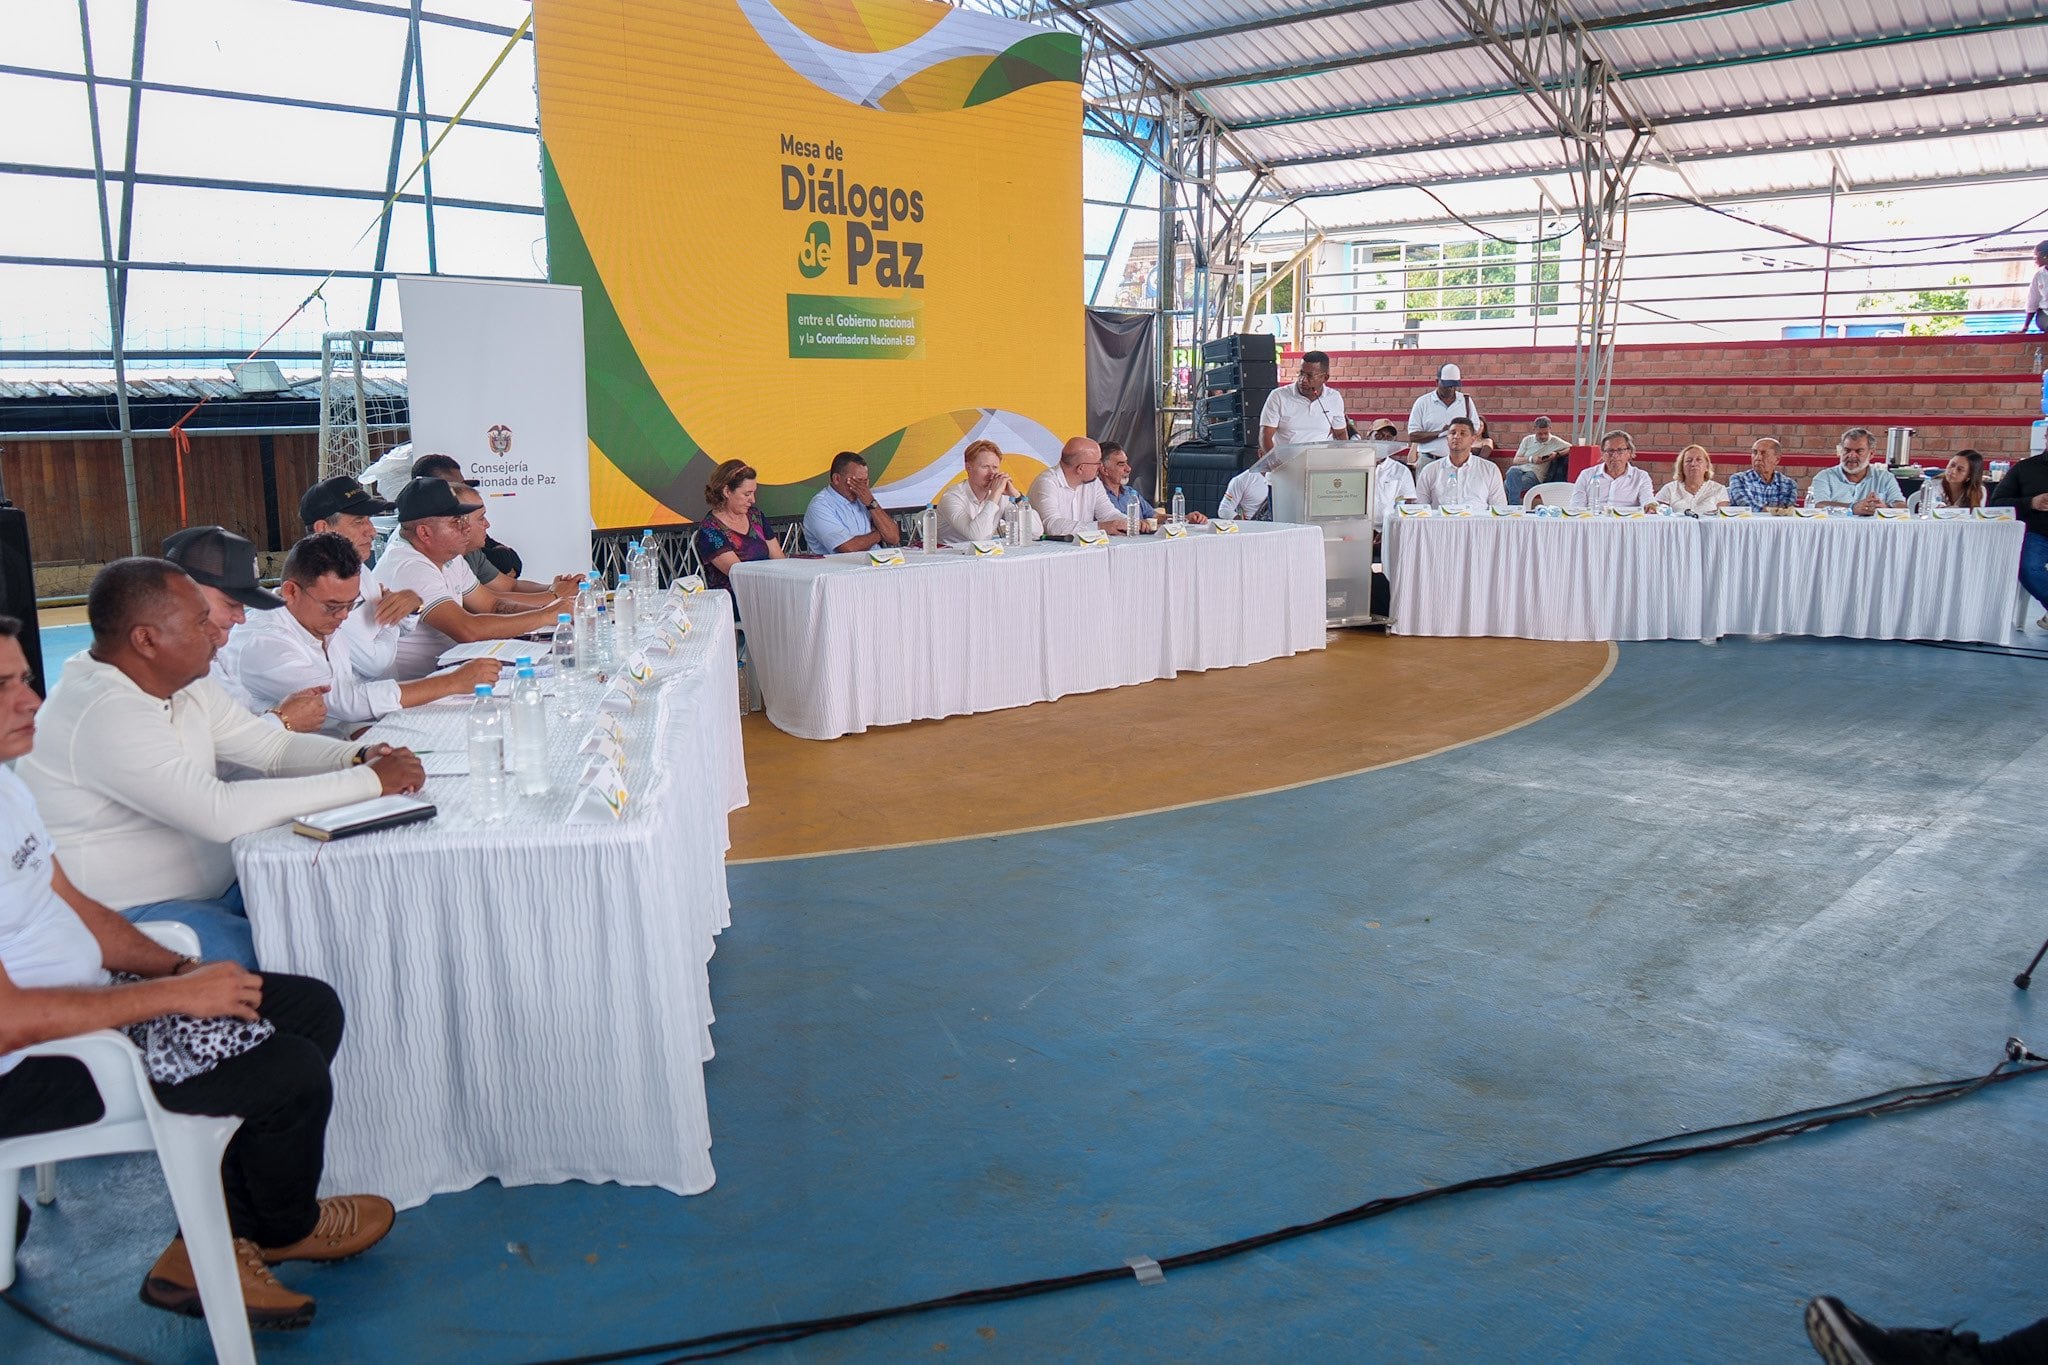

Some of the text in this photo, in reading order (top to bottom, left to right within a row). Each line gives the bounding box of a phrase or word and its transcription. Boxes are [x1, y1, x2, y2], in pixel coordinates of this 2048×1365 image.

[780, 133, 843, 161] Mesa de
[781, 163, 924, 231] Diálogos
[799, 221, 924, 289] de Paz
[798, 314, 915, 329] entre el Gobierno nacional
[799, 335, 805, 346] y
[806, 332, 814, 344] la
[816, 333, 869, 345] Coordinadora
[470, 460, 528, 475] Consejería
[472, 474, 556, 487] ionada de Paz
